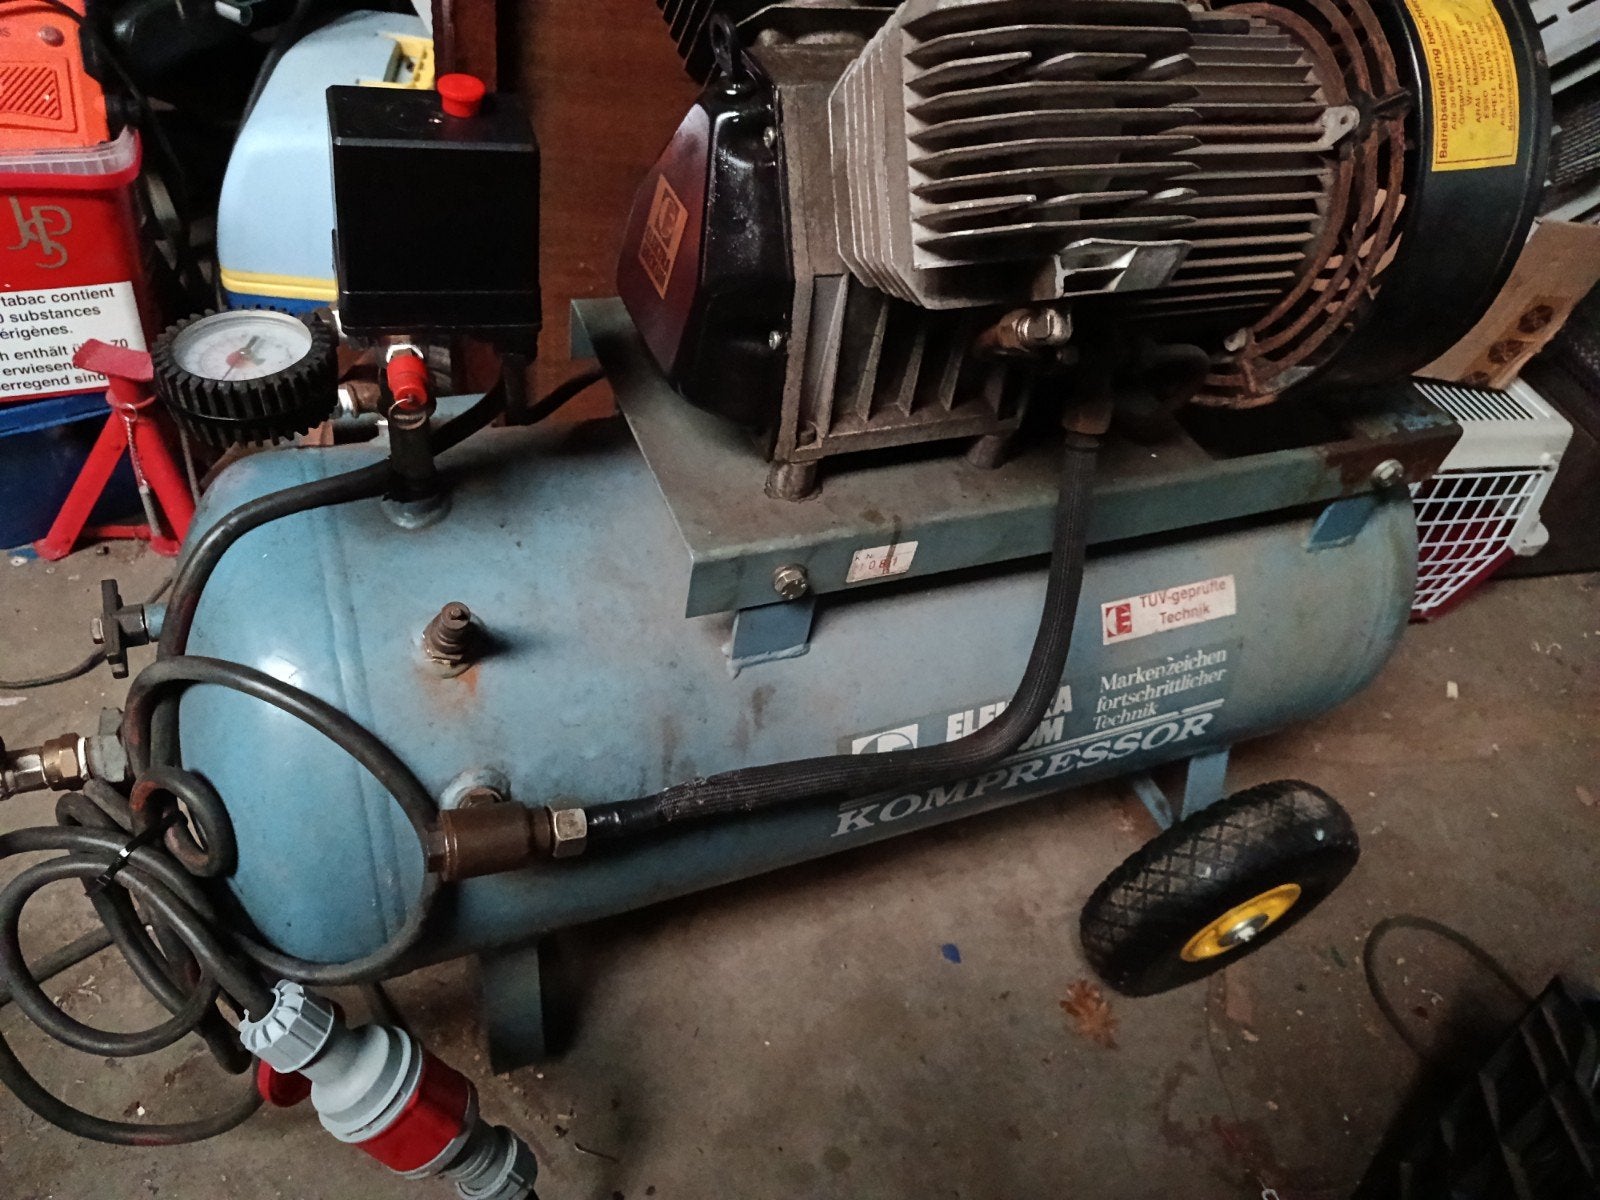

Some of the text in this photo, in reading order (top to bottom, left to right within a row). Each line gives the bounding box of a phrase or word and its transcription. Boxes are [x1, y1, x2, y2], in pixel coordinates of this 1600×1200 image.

[1, 287, 115, 308] tabac contient
[9, 305, 102, 324] substances
[14, 345, 69, 361] enthält
[1159, 603, 1211, 626] Technik
[1101, 650, 1227, 693] Markenzeichen
[1095, 668, 1227, 714] fortschrittlicher
[1093, 702, 1159, 731] Technik
[830, 712, 1214, 838] KOMPRESSOR
